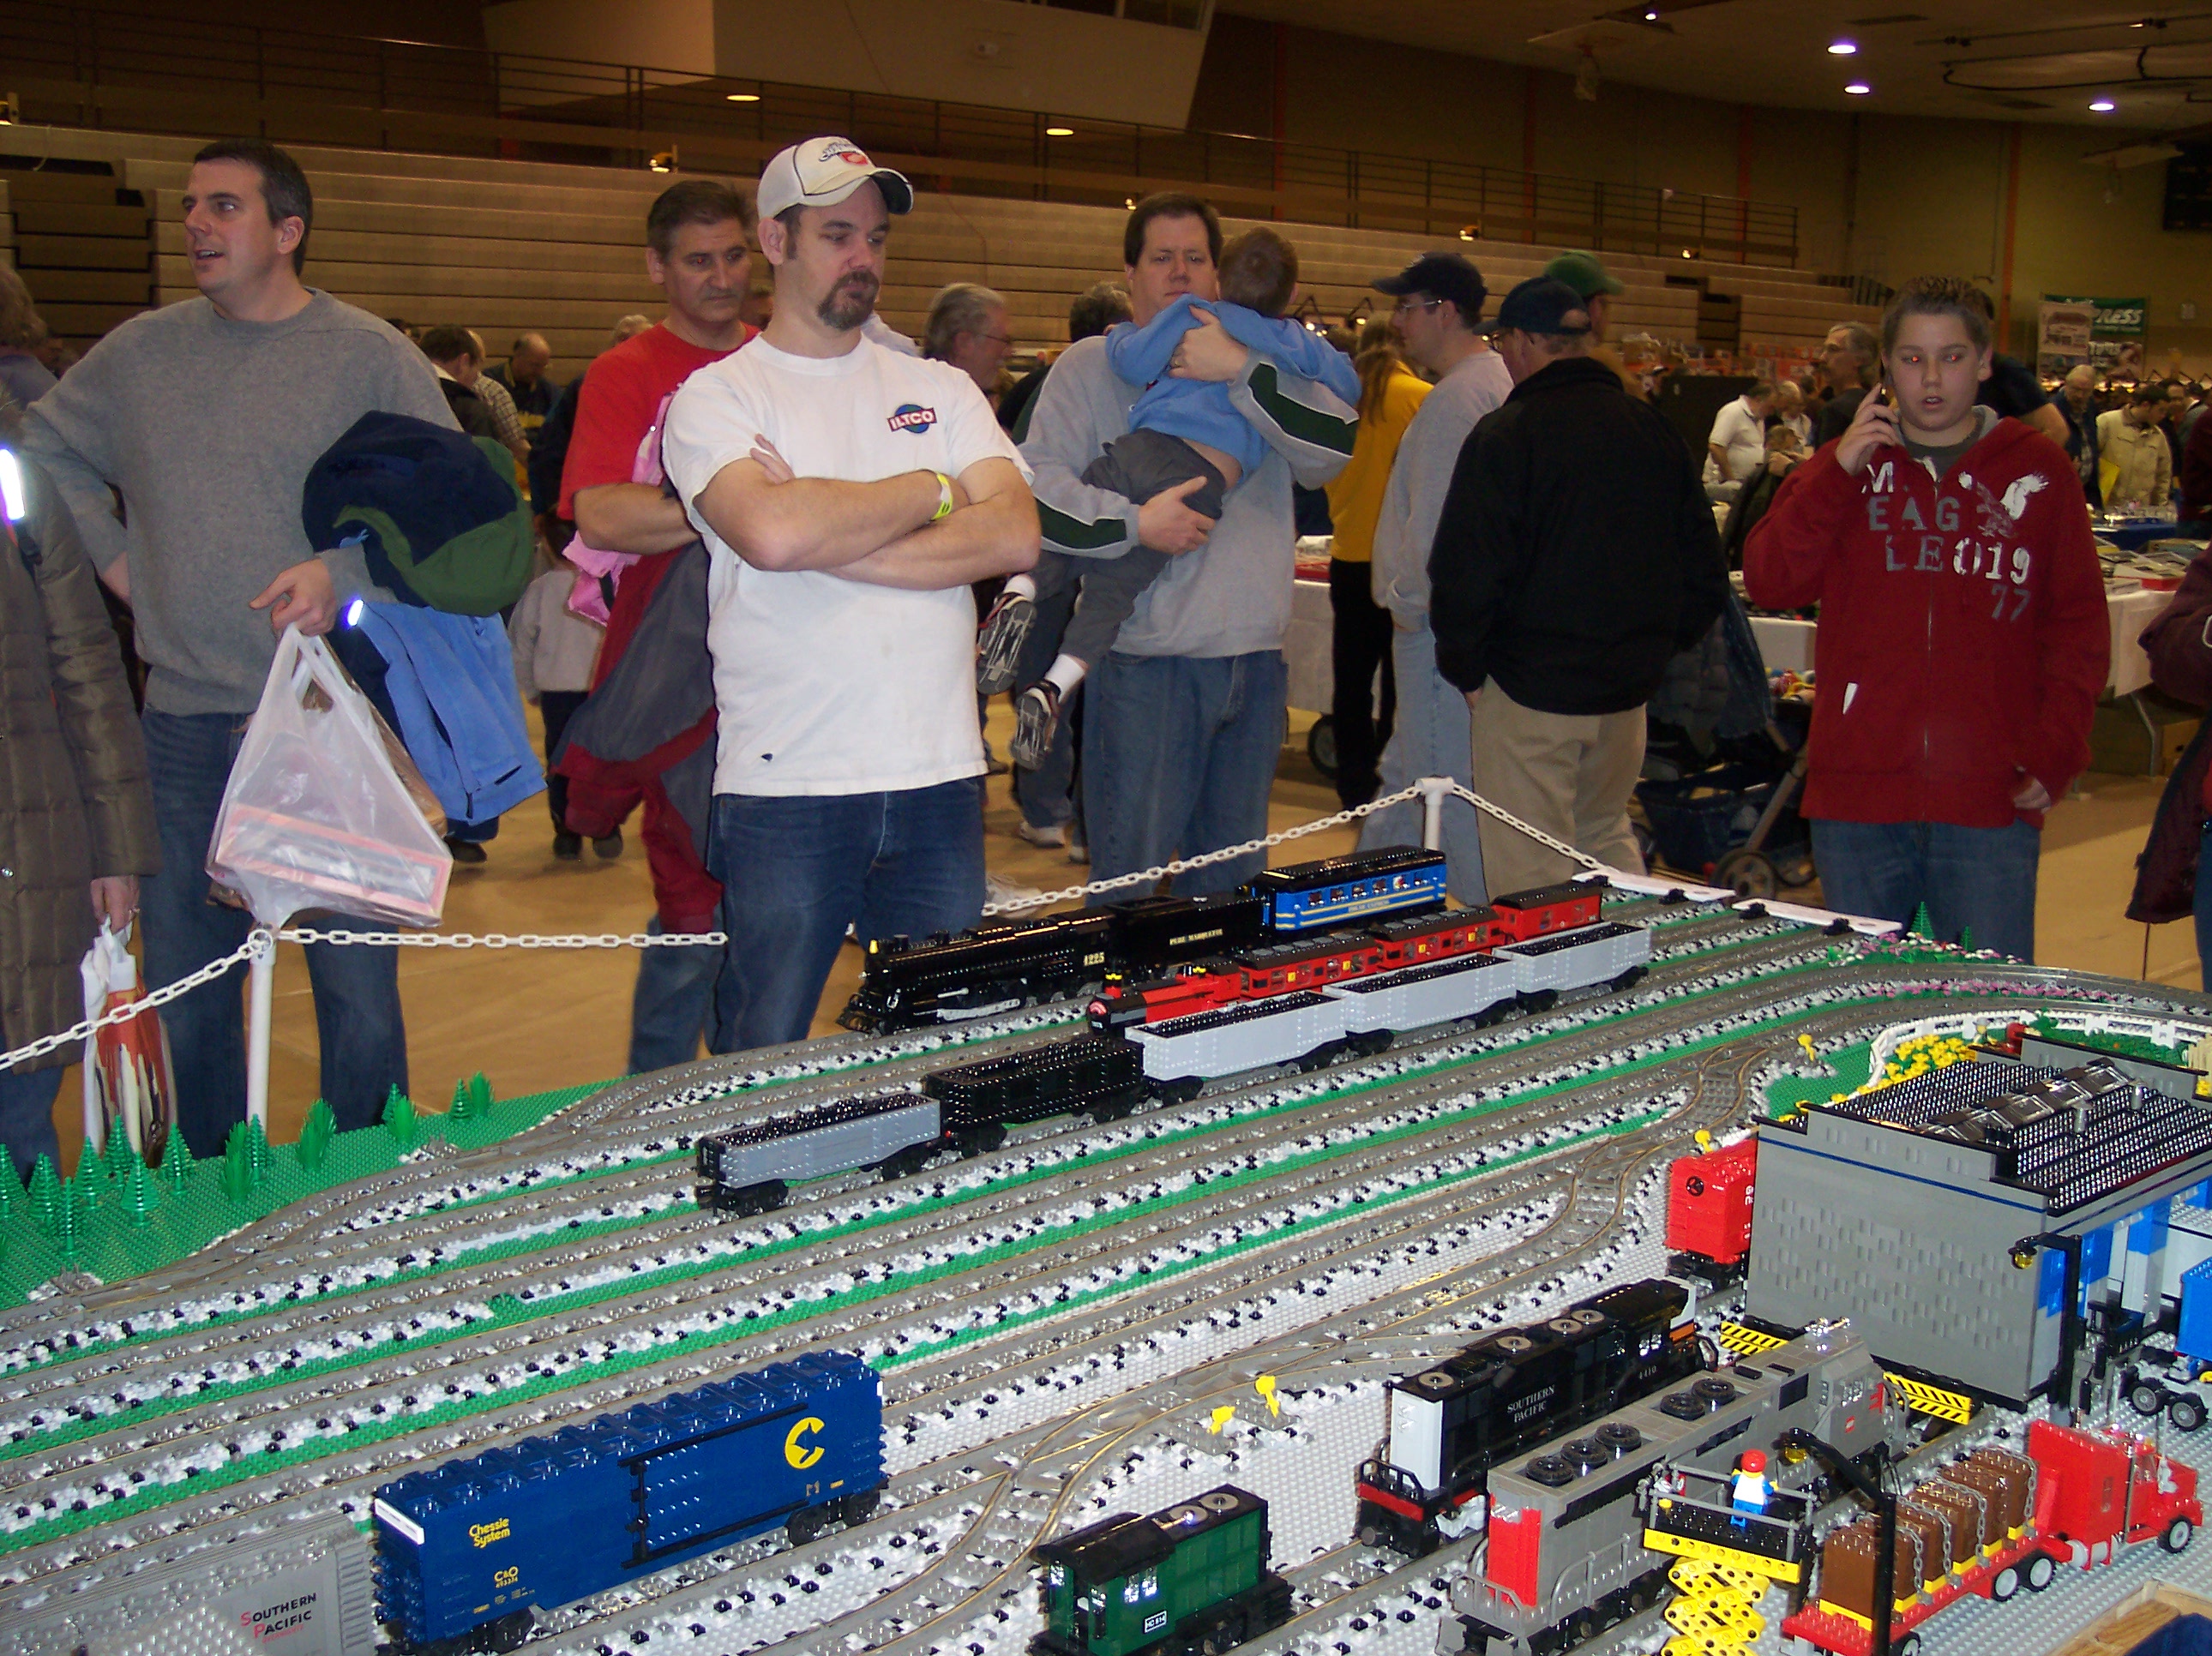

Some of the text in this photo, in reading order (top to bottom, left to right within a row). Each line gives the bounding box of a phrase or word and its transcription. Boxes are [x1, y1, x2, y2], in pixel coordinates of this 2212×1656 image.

[469, 1517, 509, 1538] Chessie
[473, 1528, 511, 1548] System
[240, 1593, 316, 1626] SOUTHERN
[254, 1611, 312, 1638] PACIFIC
